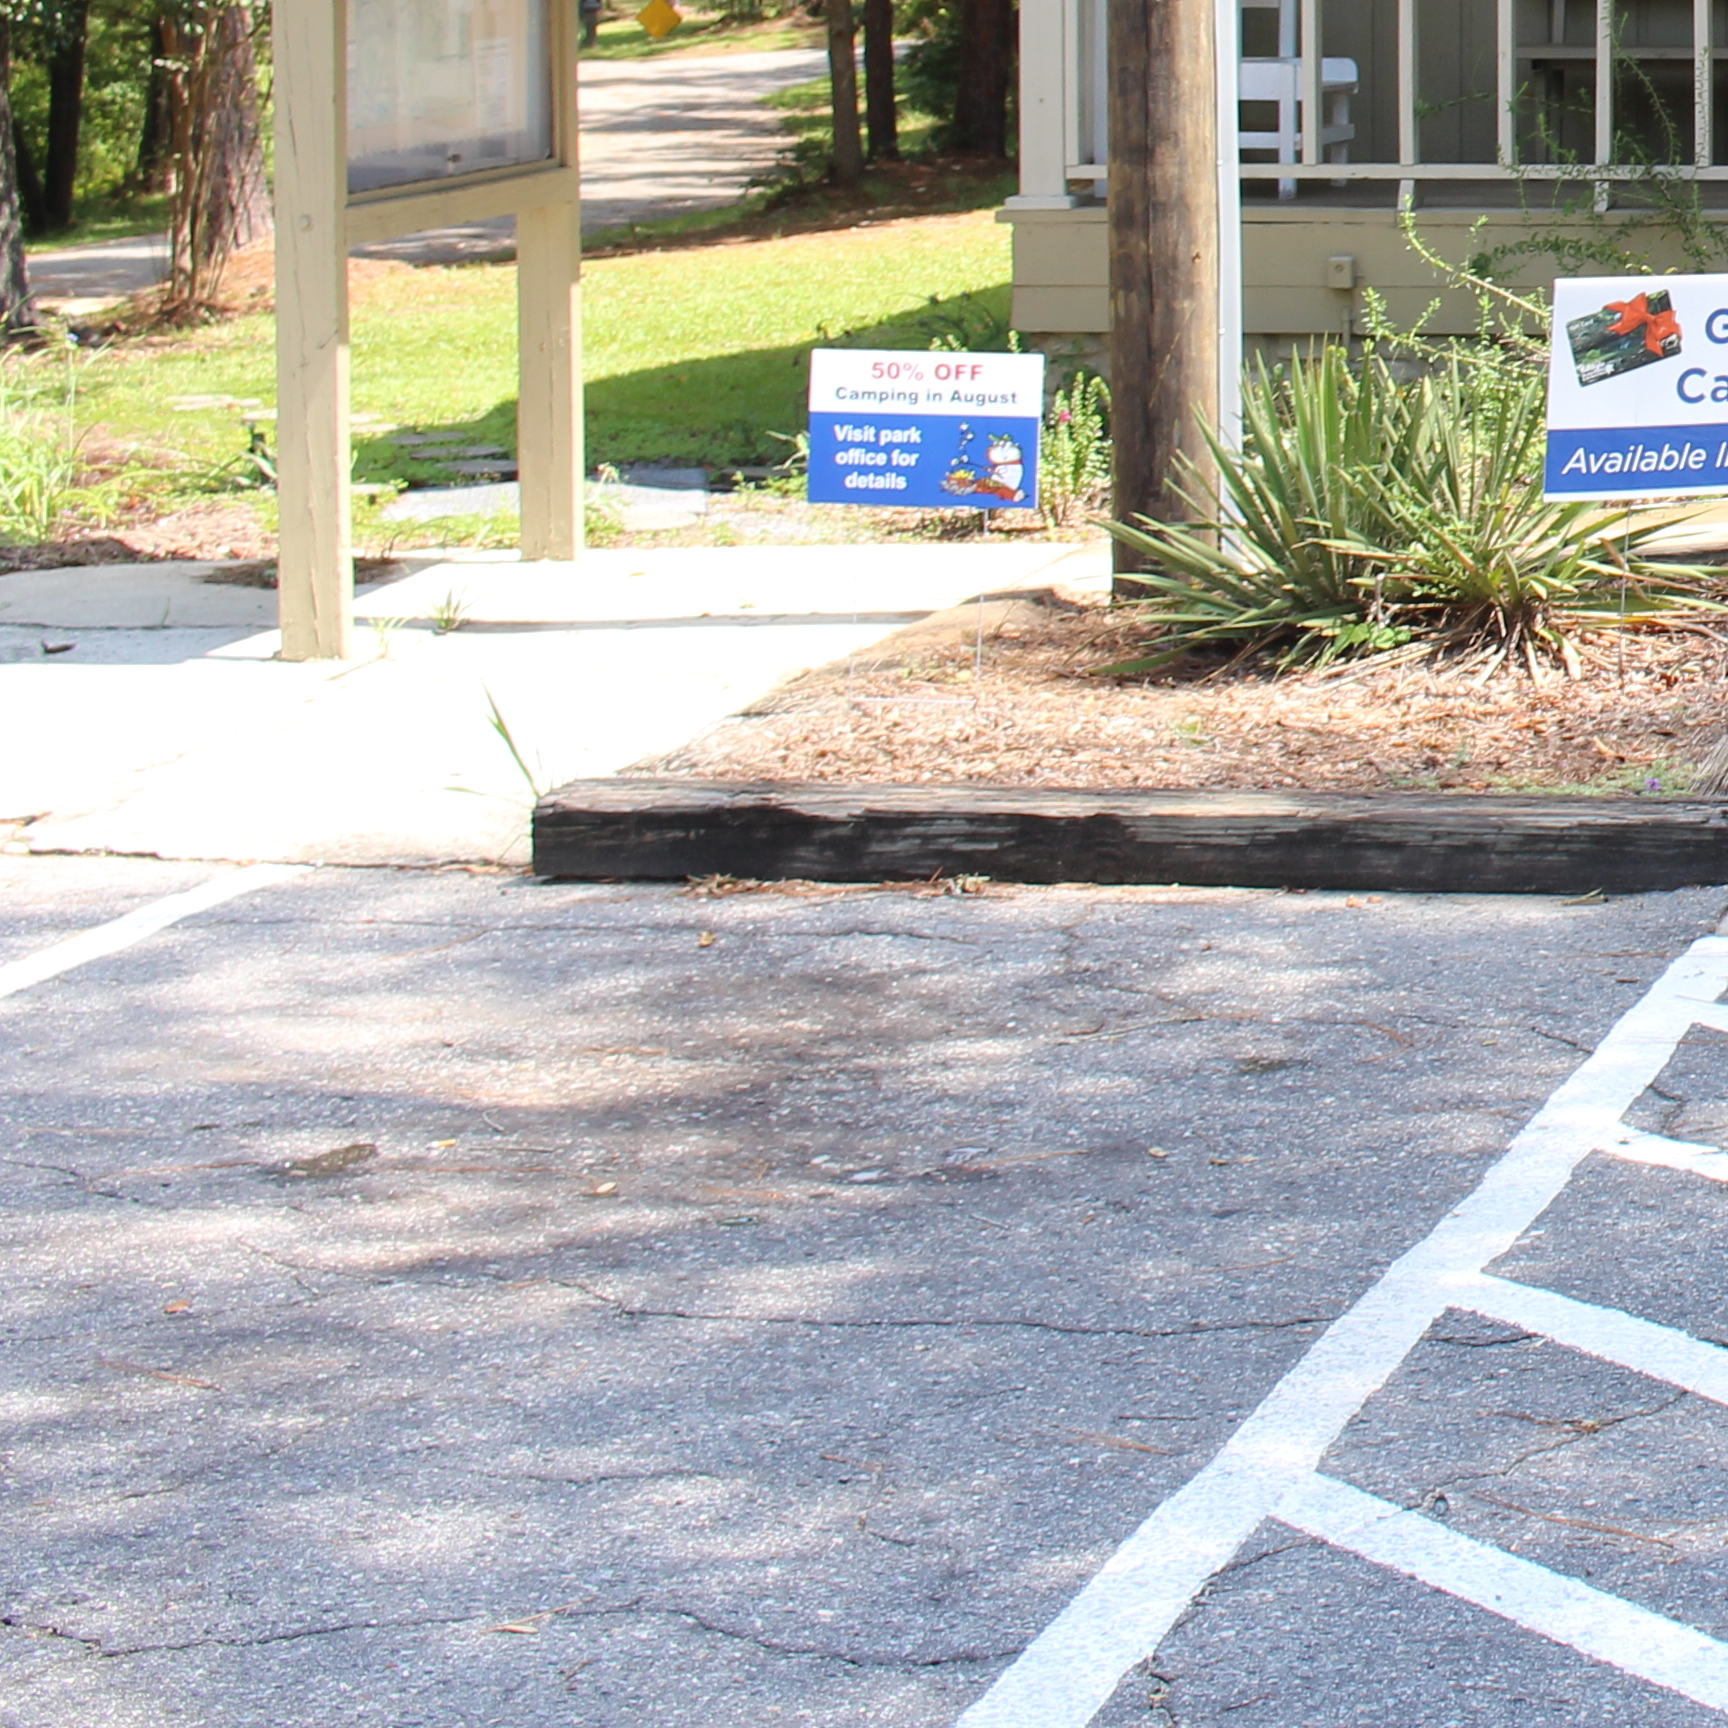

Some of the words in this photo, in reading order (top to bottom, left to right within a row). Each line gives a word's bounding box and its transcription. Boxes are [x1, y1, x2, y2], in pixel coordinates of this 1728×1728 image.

[871, 361, 925, 381] 50%
[934, 363, 985, 381] OFF
[835, 386, 920, 405] Camping
[926, 388, 943, 403] in
[949, 389, 1018, 406] August
[833, 424, 876, 443] Visit
[879, 425, 923, 447] park
[834, 447, 888, 467] office
[890, 448, 920, 467] for
[1561, 441, 1708, 476] Available
[843, 470, 908, 490] details
